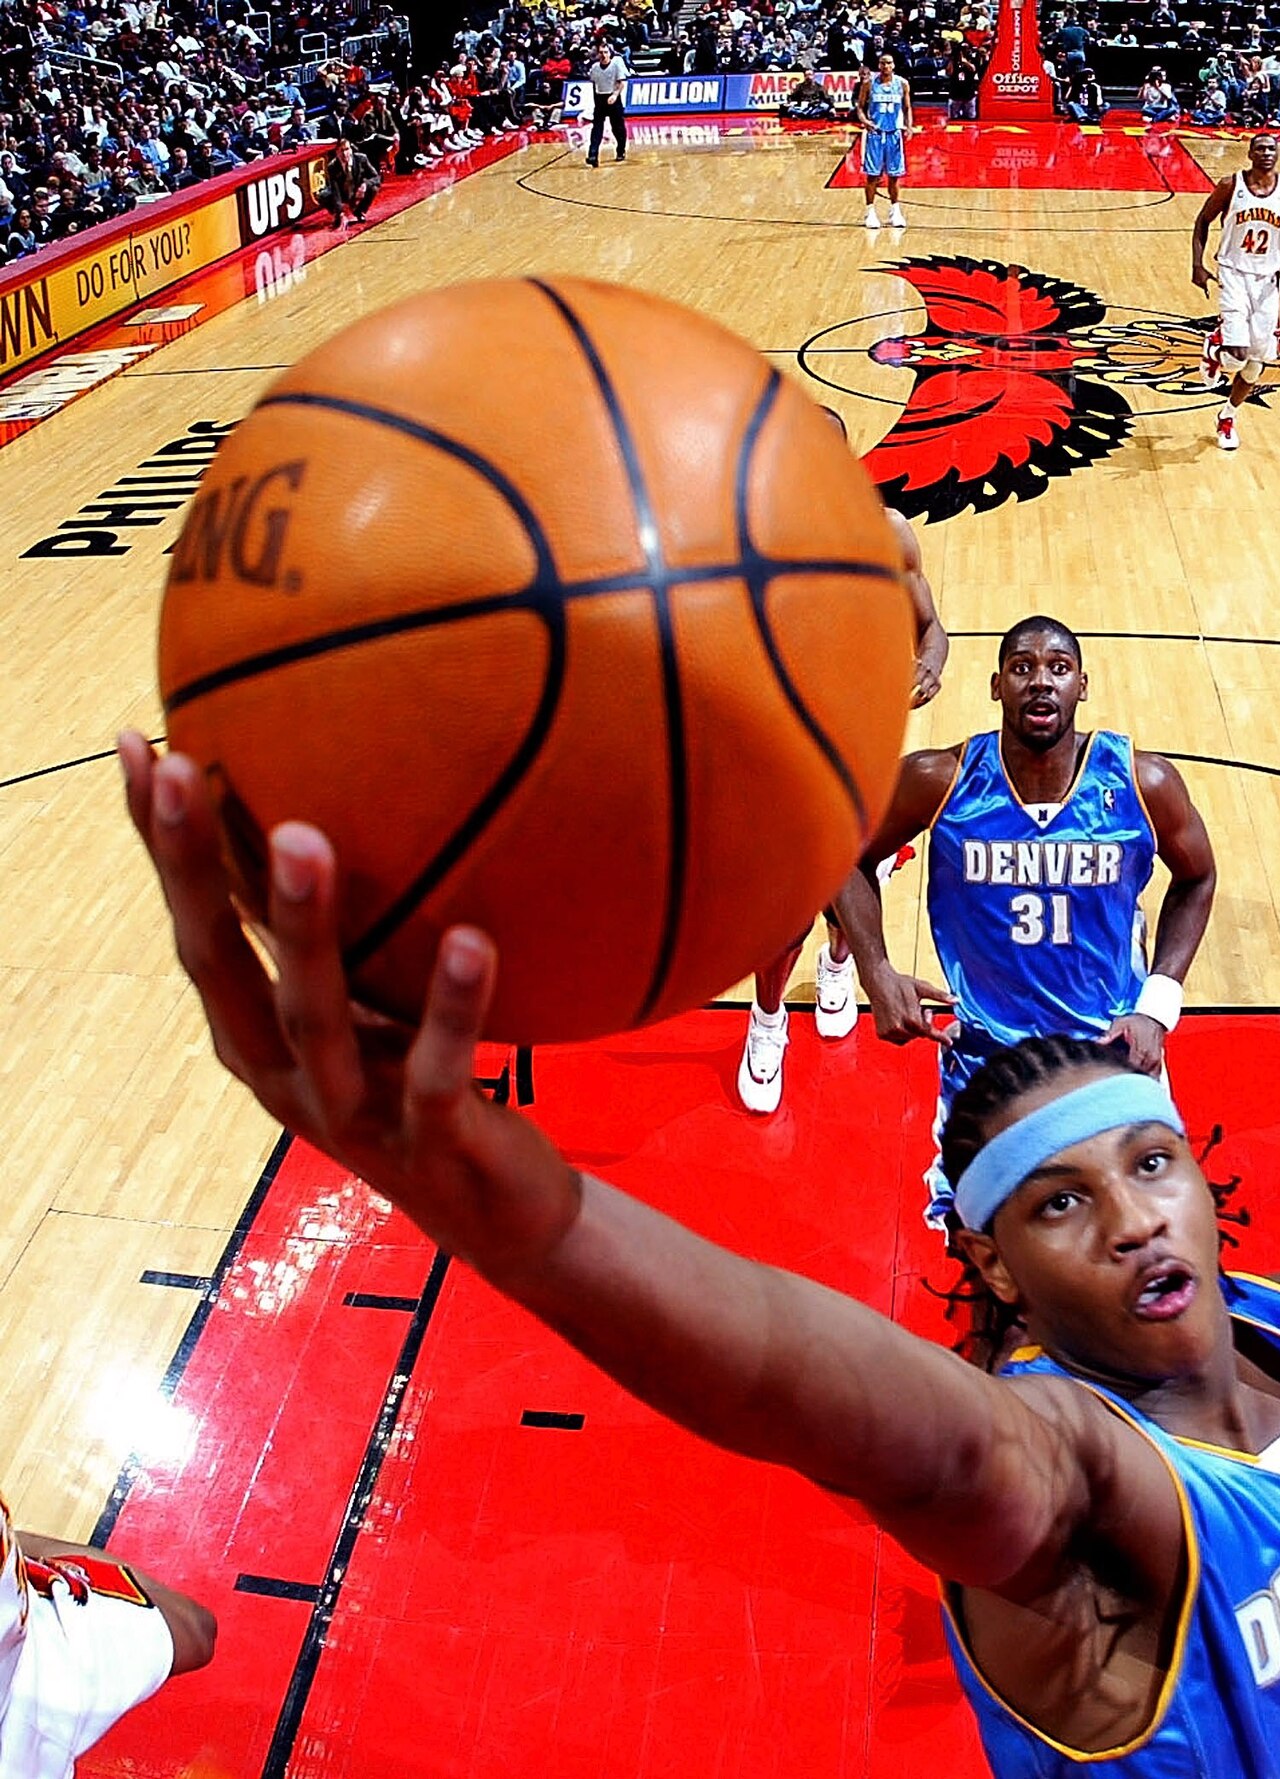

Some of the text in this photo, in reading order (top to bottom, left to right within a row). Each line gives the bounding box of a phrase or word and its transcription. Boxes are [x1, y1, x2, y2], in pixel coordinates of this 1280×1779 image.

[568, 81, 720, 107] $ MILLION
[751, 74, 800, 94] MEG
[993, 73, 1039, 84] Office
[247, 166, 302, 235] UPS
[1241, 229, 1268, 254] 42
[76, 262, 104, 307] DO
[109, 244, 147, 290] FOR
[149, 223, 190, 270] YOU?
[963, 839, 1123, 886] DENVER
[1010, 893, 1072, 945] 31
